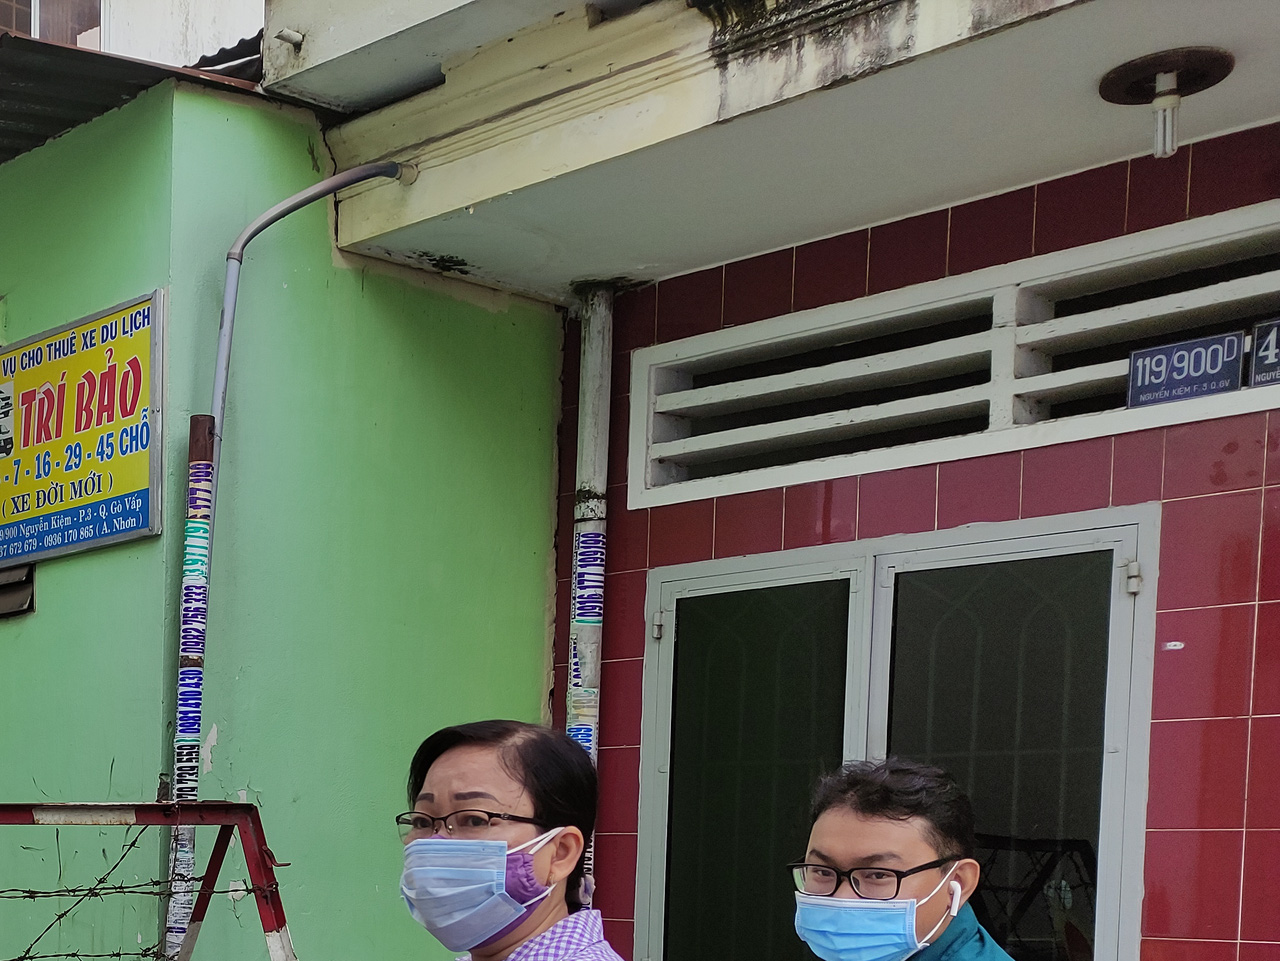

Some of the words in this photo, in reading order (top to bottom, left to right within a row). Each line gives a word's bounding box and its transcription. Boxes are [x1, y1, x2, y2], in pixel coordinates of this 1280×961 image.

[2, 356, 17, 378] VỤ
[20, 346, 43, 371] CHO
[46, 331, 77, 362] THUÊ
[81, 328, 97, 351] XE
[101, 320, 118, 345] DU
[121, 306, 151, 338] LỊCH
[1258, 327, 1280, 364] 4
[20, 371, 68, 449] TRÍ
[75, 347, 142, 434] BẢO
[13, 459, 21, 486] 7
[35, 450, 51, 480] 16
[64, 441, 82, 472] 29
[96, 432, 114, 463] 45
[119, 407, 150, 457] CHỖ
[35, 481, 64, 509] ĐỜI
[69, 470, 103, 501] MỚI
[9, 542, 22, 555] 672
[24, 538, 37, 552] 679
[44, 533, 62, 547] 0936
[64, 529, 78, 543] 170
[80, 525, 93, 540] 865
[112, 516, 136, 532] Nhơn
[20, 517, 49, 538] Nguyễn
[51, 515, 72, 529] Kiệm
[110, 500, 122, 514] Gò
[124, 493, 142, 511] Vấp
